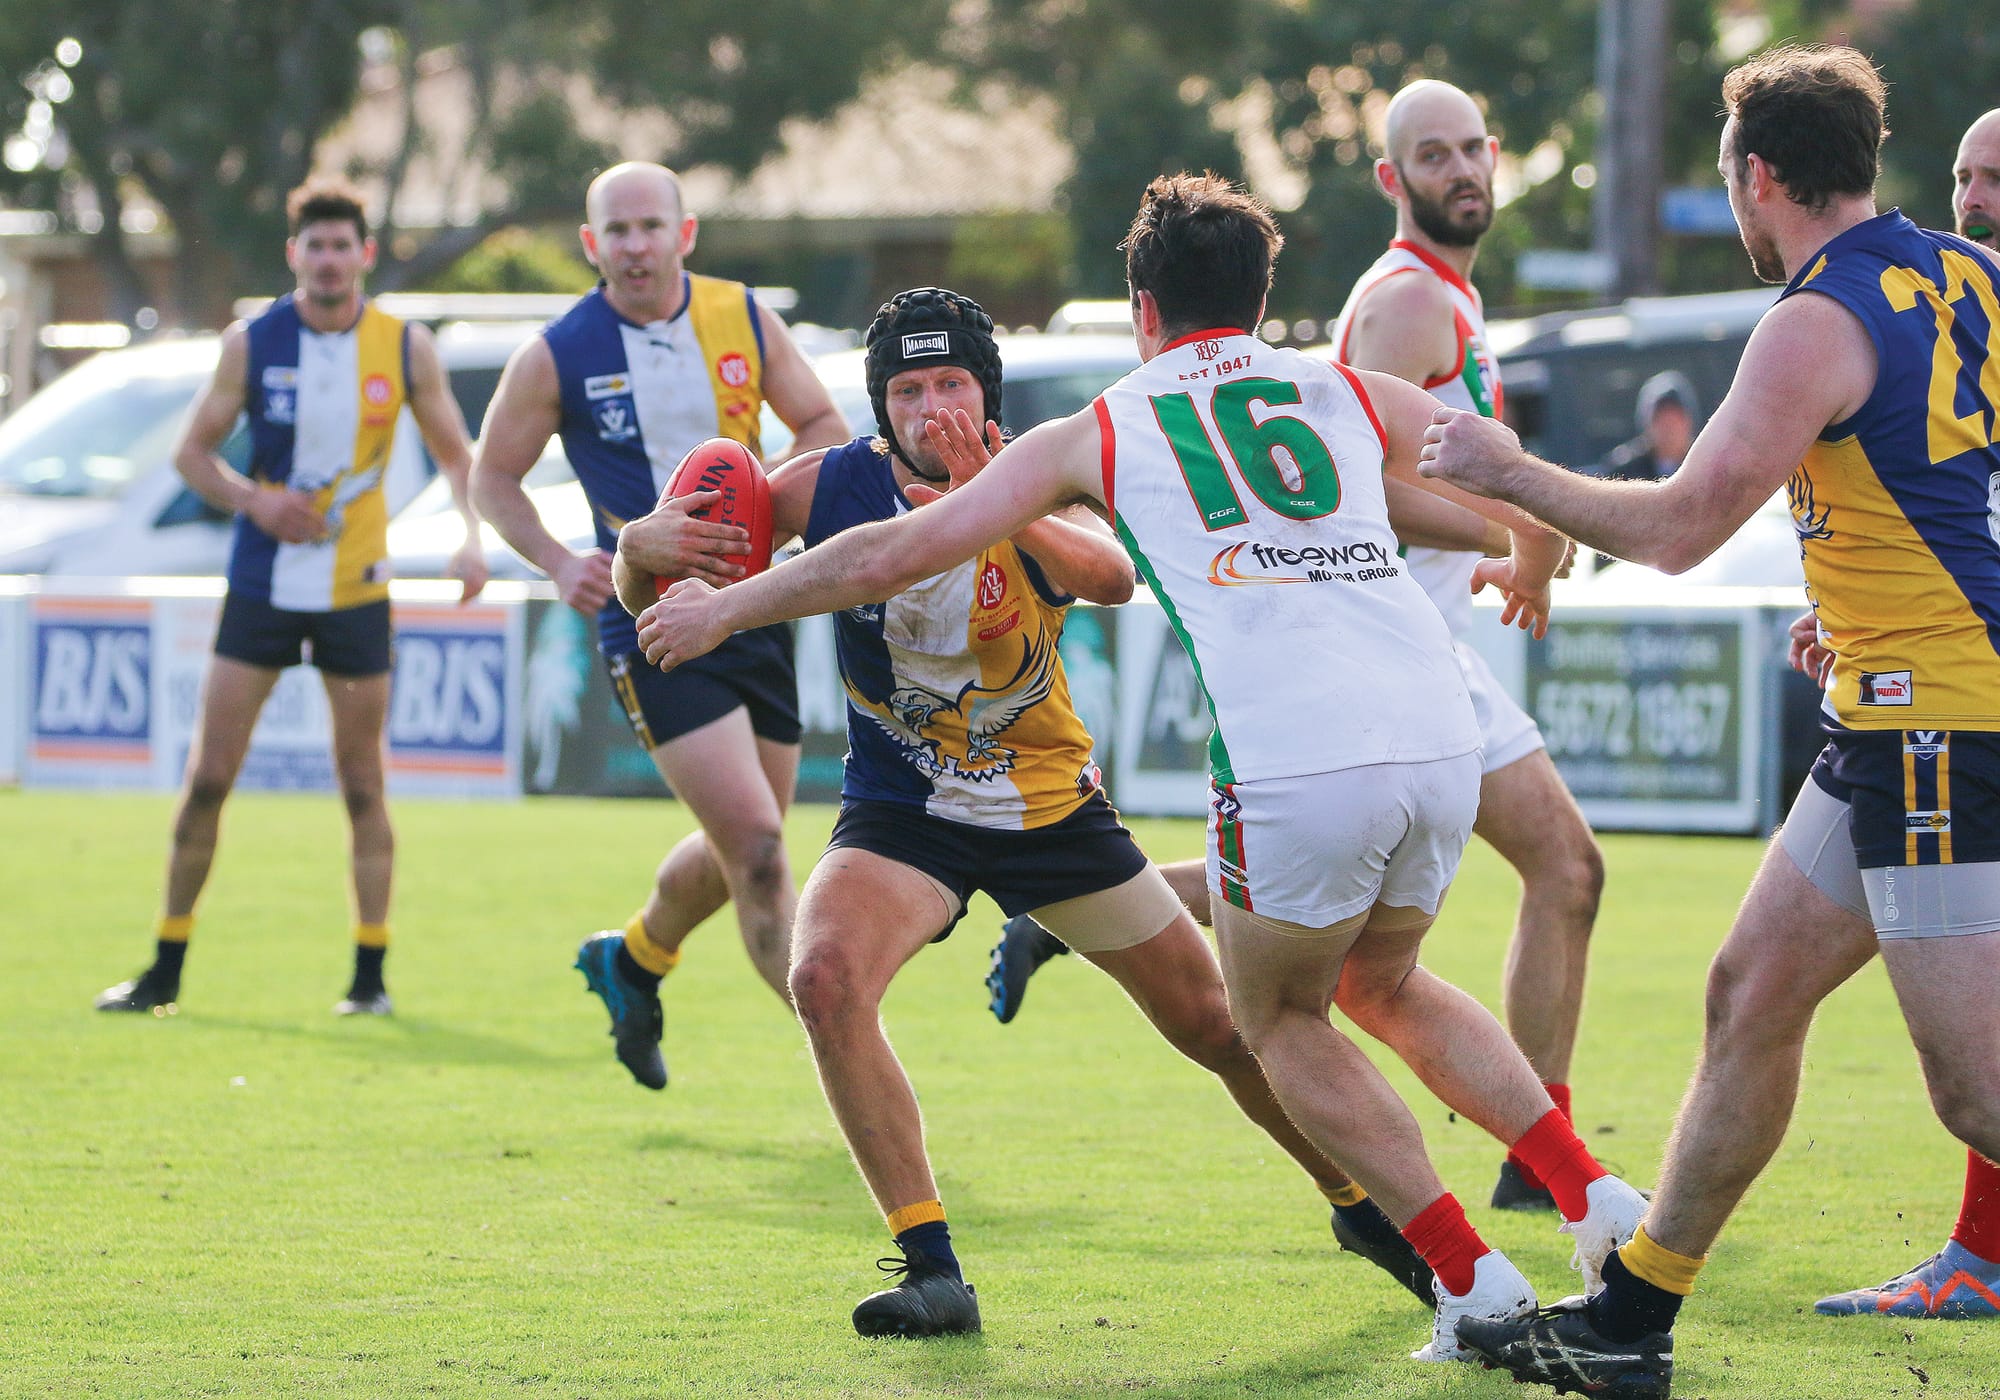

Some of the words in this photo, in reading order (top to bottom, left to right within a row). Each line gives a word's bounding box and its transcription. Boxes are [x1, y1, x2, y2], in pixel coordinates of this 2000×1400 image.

[905, 335, 946, 355] MADISON
[1178, 368, 1209, 381] EST
[1216, 355, 1251, 376] 1947
[1148, 377, 1342, 532] 16
[1209, 507, 1238, 520] CGR
[1252, 542, 1389, 569] freeway
[1308, 570, 1356, 583] MOTOR
[1357, 567, 1399, 582] GROUP
[1876, 688, 1904, 697] PUMA
